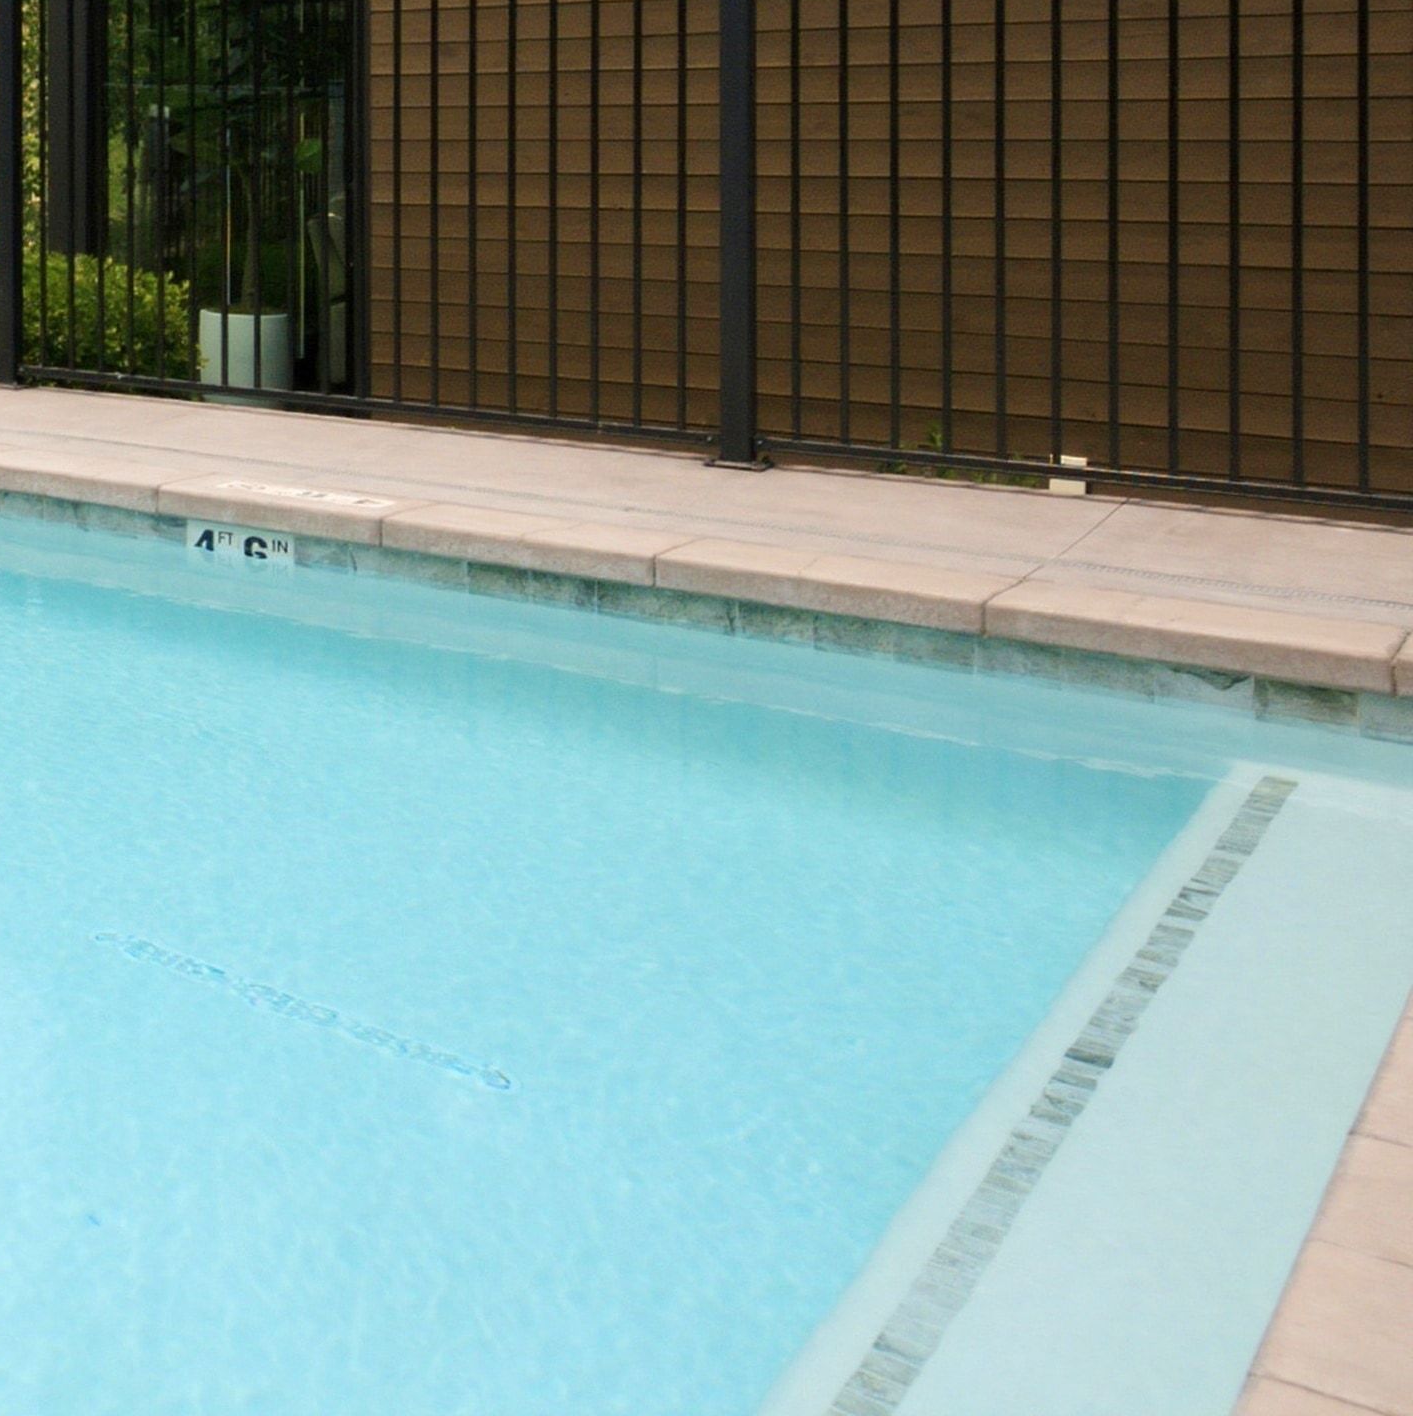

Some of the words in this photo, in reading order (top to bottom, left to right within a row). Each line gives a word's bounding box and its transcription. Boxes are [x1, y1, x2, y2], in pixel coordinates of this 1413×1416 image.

[194, 529, 214, 552] 4
[218, 531, 233, 546] FT
[272, 539, 288, 554] IN
